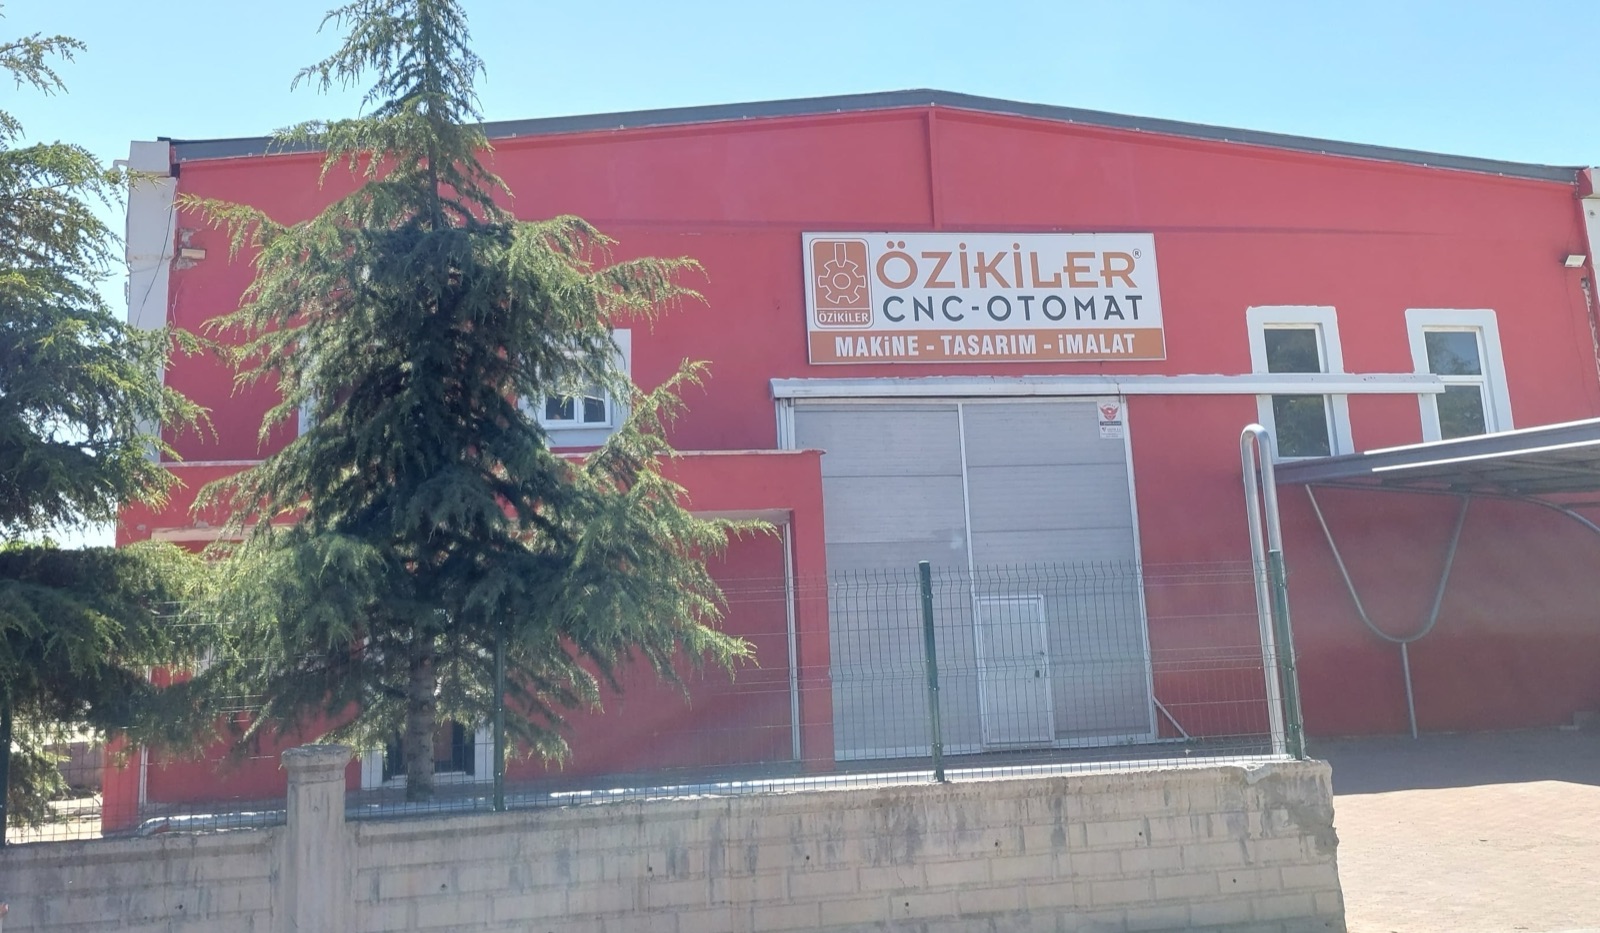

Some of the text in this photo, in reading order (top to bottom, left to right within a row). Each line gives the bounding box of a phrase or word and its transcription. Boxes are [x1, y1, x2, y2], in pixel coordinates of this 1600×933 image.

[875, 240, 1138, 289] ÖZİKİLER
[883, 295, 1143, 322] CNC-OTOMAT
[941, 335, 1037, 356] TASARIM
